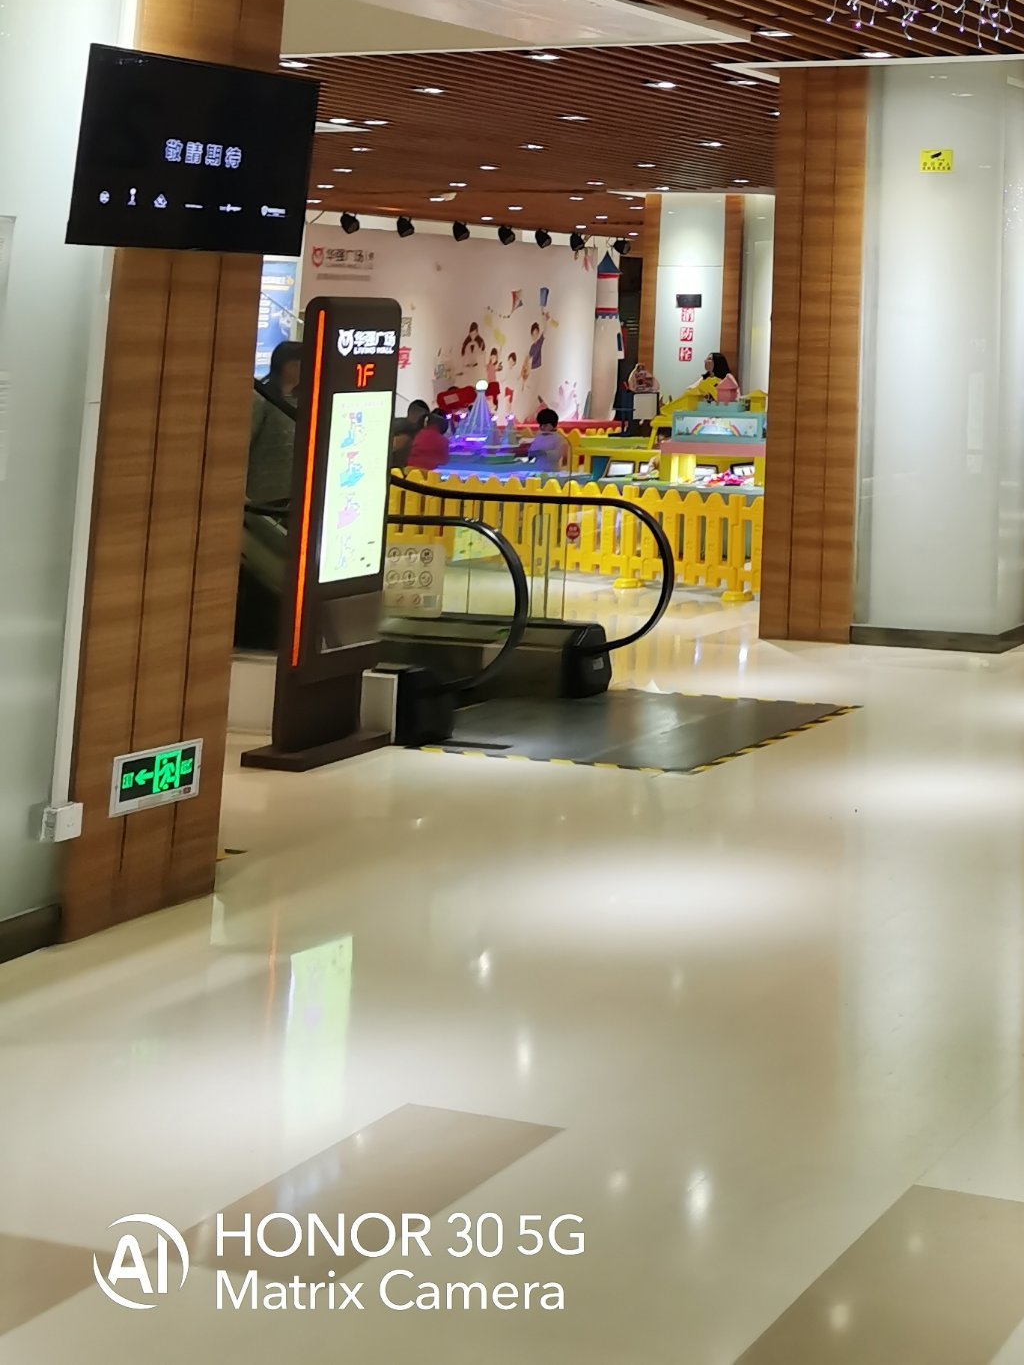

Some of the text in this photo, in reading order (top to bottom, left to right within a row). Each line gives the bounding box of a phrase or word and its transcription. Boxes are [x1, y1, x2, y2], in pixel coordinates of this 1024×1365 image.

[353, 331, 396, 347] 华强广场
[356, 363, 375, 387] 1F
